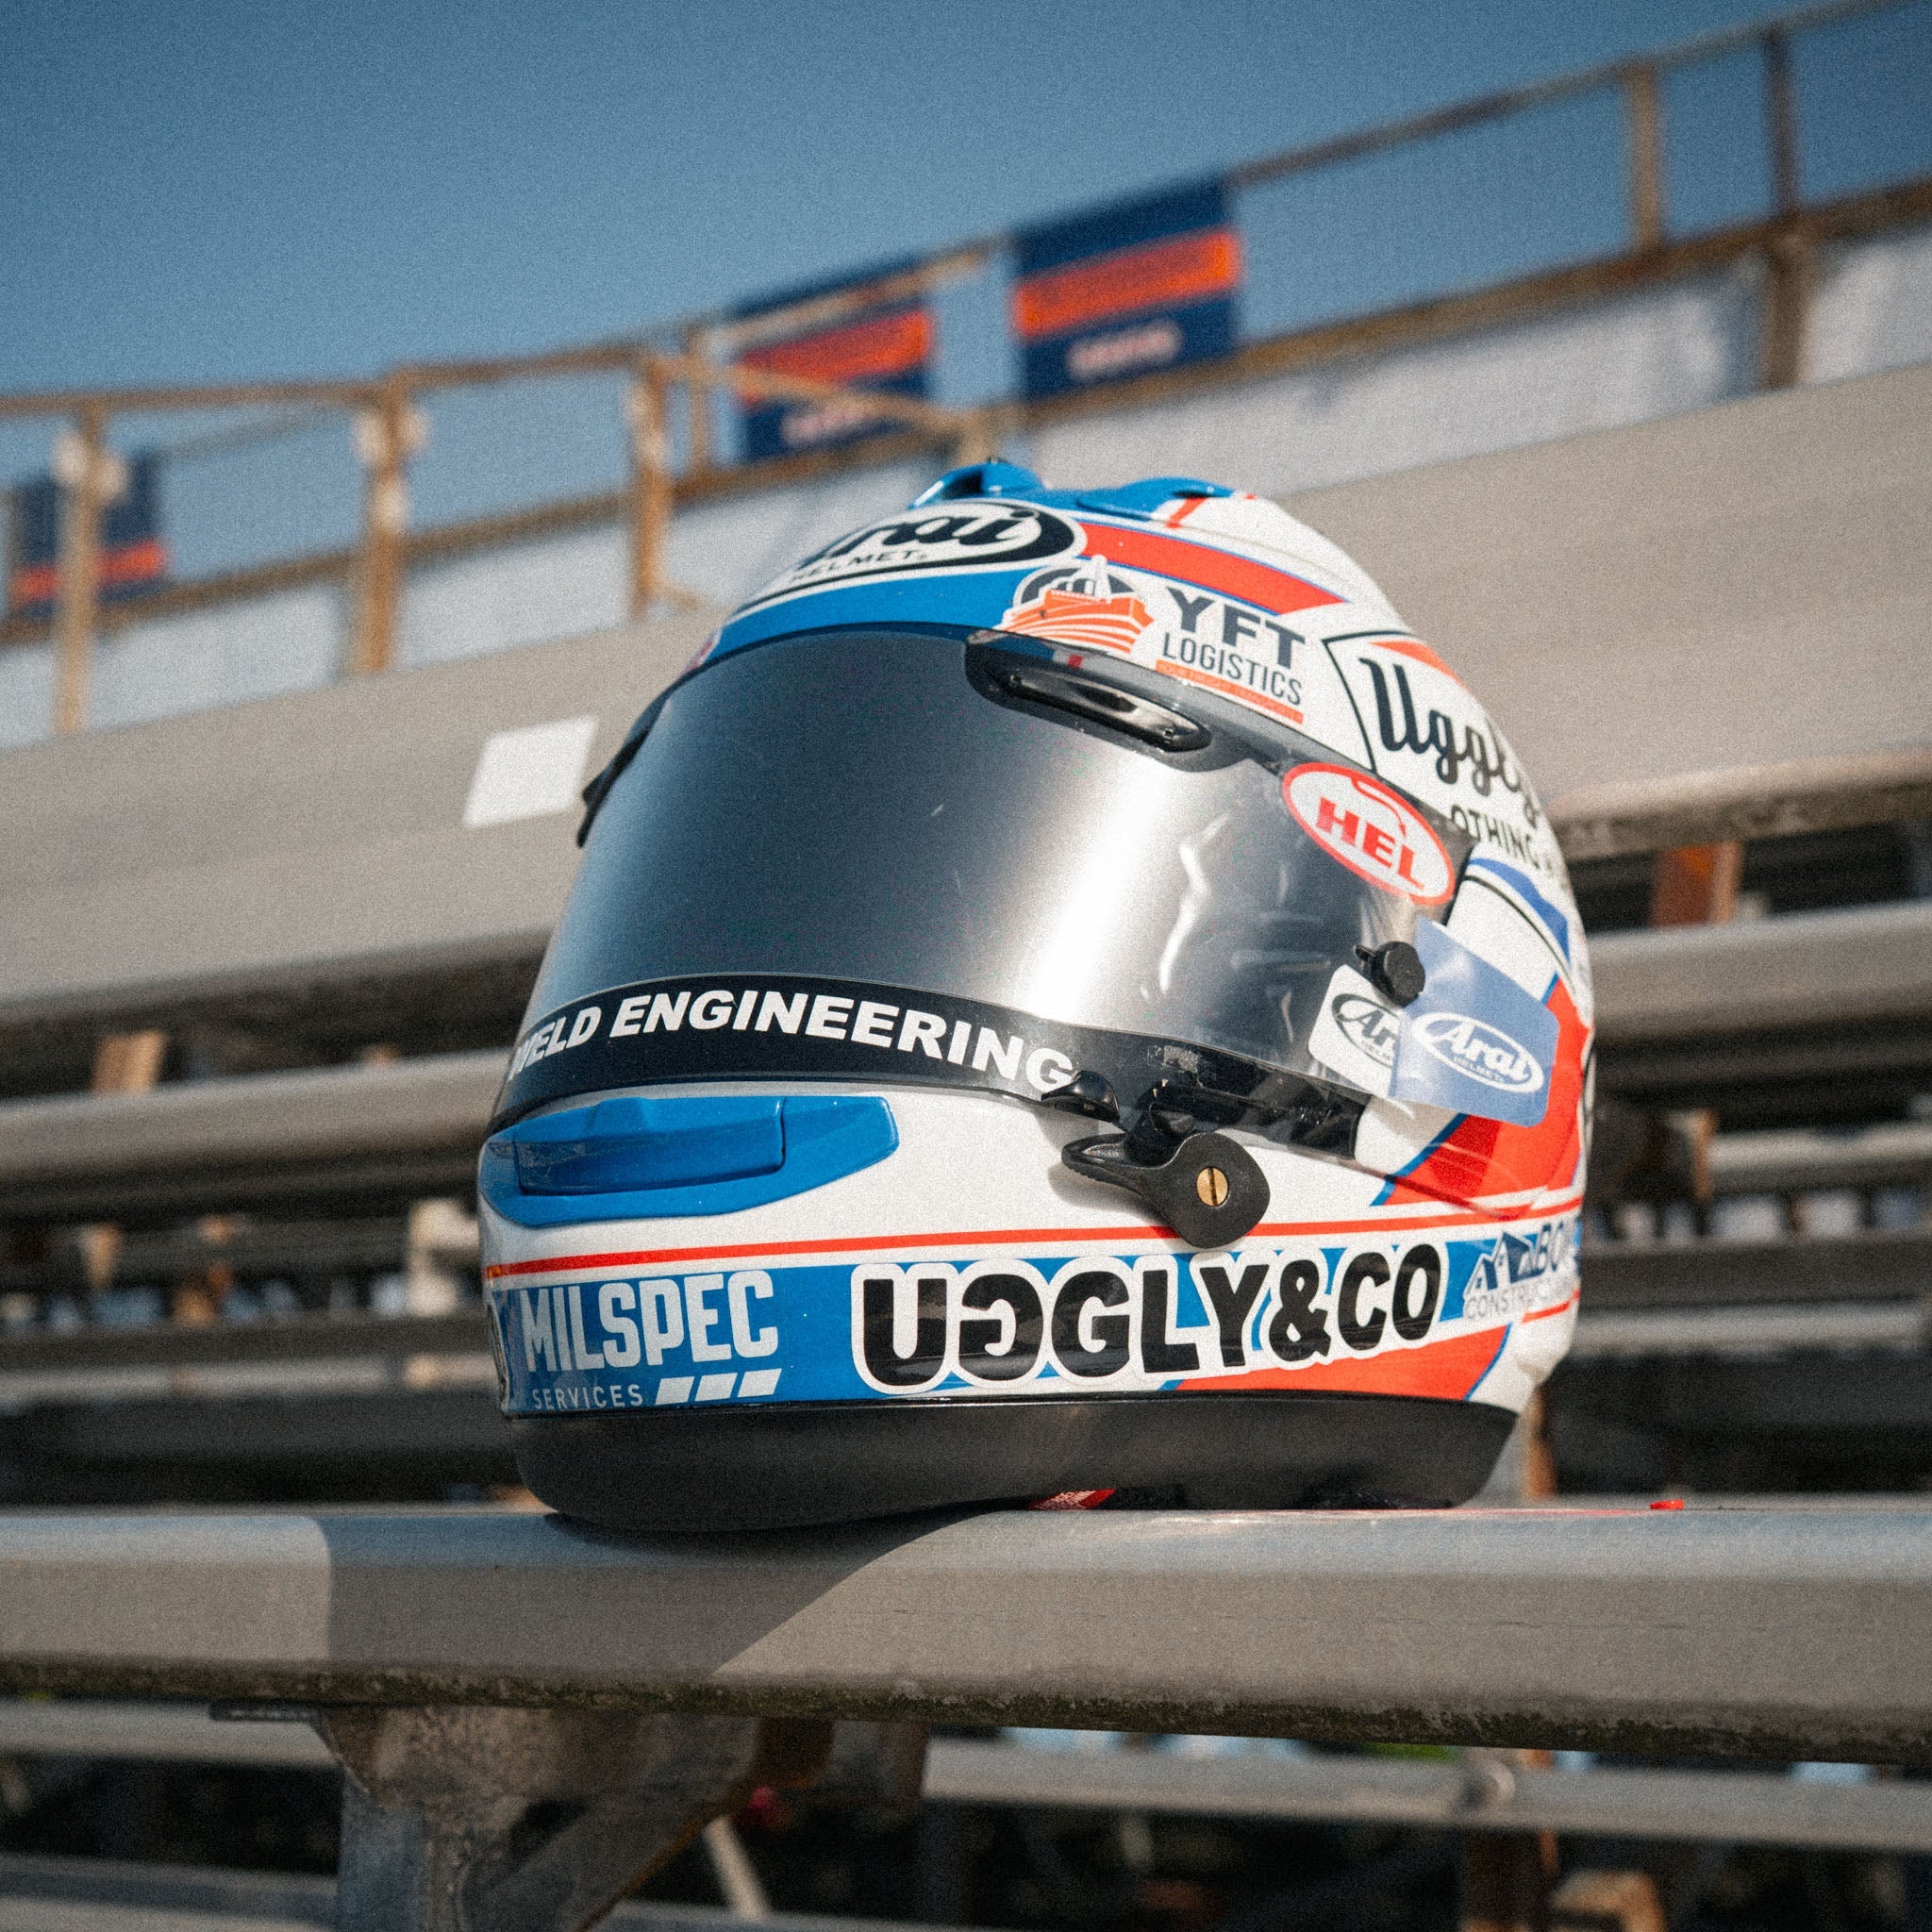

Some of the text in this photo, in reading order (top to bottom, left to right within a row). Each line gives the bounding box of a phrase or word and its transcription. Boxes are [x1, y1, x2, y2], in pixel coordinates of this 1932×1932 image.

[811, 510, 1035, 563] rai
[1166, 587, 1306, 669] YFT
[1162, 632, 1302, 706] LOGISTICS
[1316, 796, 1425, 891] HEL
[609, 990, 1074, 1093] ENGINEERING
[1335, 1008, 1399, 1049] Ar
[1430, 1021, 1533, 1082] Arai
[521, 1270, 778, 1373] MILSPEC
[533, 1384, 643, 1409] SERVICES
